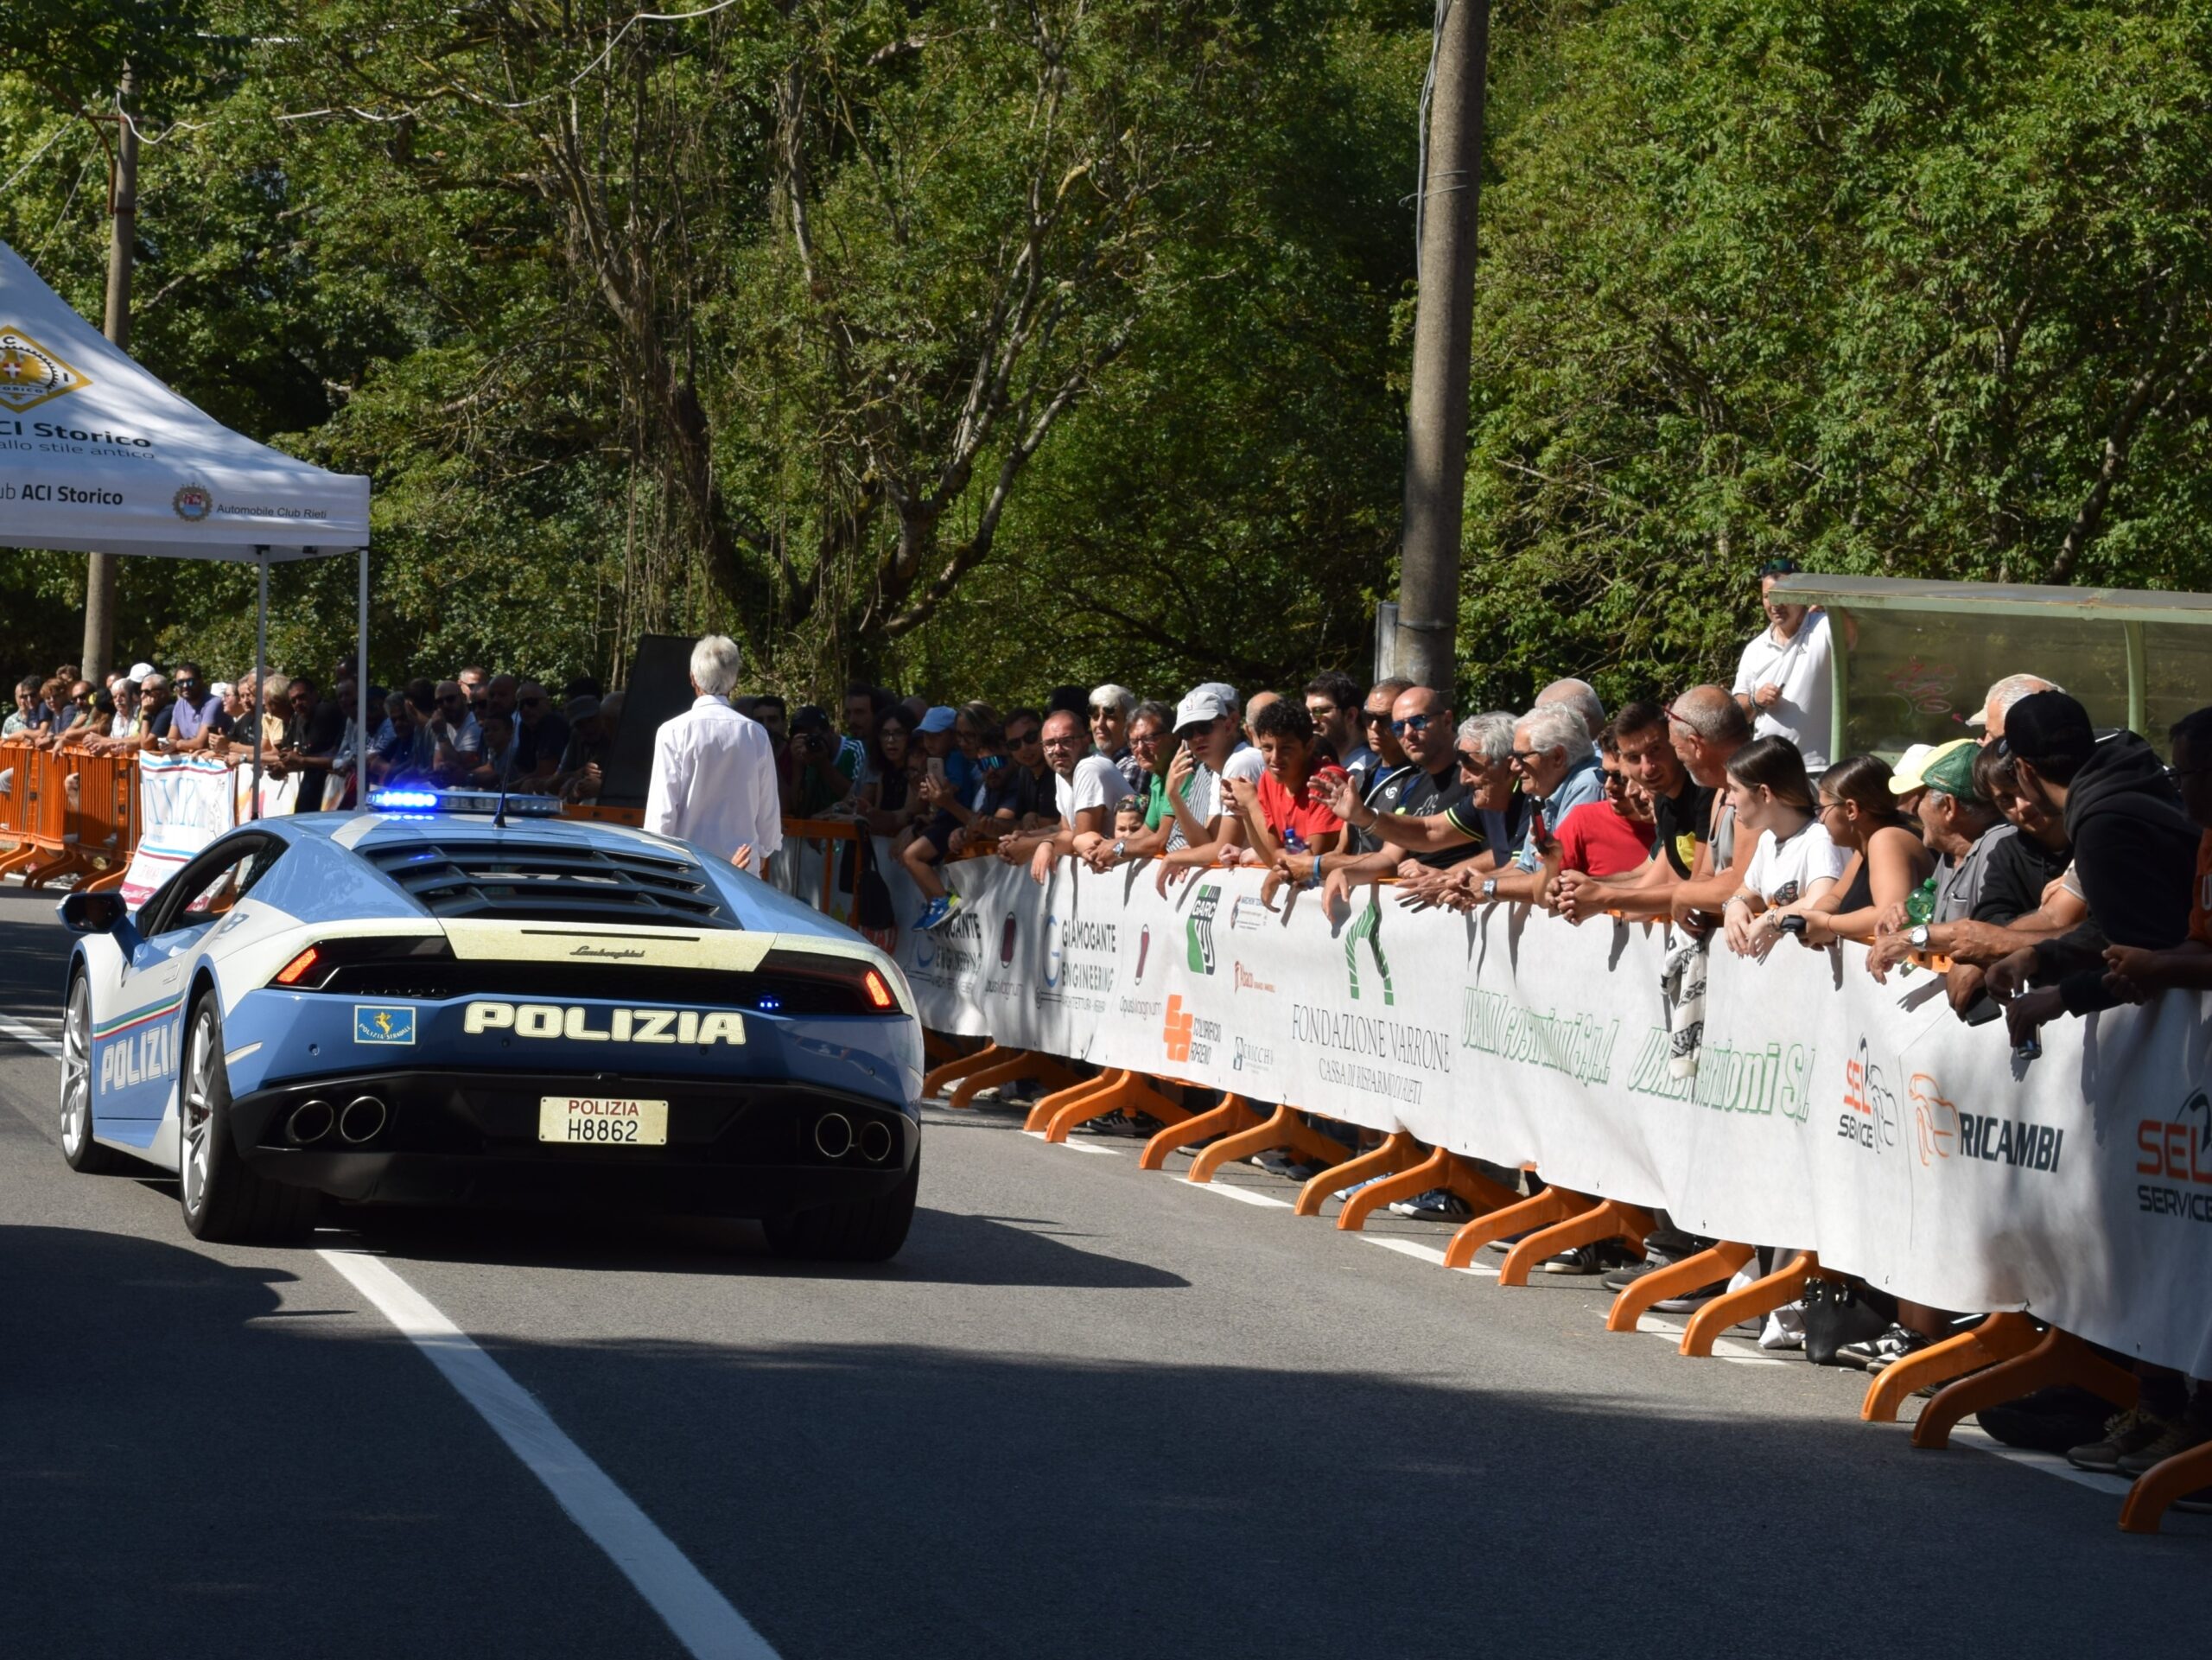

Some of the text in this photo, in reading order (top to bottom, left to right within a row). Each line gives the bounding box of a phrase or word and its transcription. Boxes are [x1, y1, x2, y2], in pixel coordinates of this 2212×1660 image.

[33, 422, 151, 448] Storico
[39, 442, 84, 455] stile
[90, 448, 155, 459] antico
[21, 484, 52, 501] ACI
[58, 486, 124, 506] Storico
[217, 504, 327, 518] Automobile Club Rieti
[1061, 919, 1116, 953] GIAMOGANTE
[569, 945, 645, 965] Lamborghini
[464, 1002, 746, 1045] POLIZIA
[1292, 1003, 1450, 1073] FONDAZIONE VARRONE
[1319, 1057, 1346, 1085] CASSA
[1843, 1058, 1872, 1115] SEL
[567, 1098, 640, 1116] POLIZIA
[567, 1118, 639, 1143] H8862
[1958, 1111, 2064, 1173] RICAMBI
